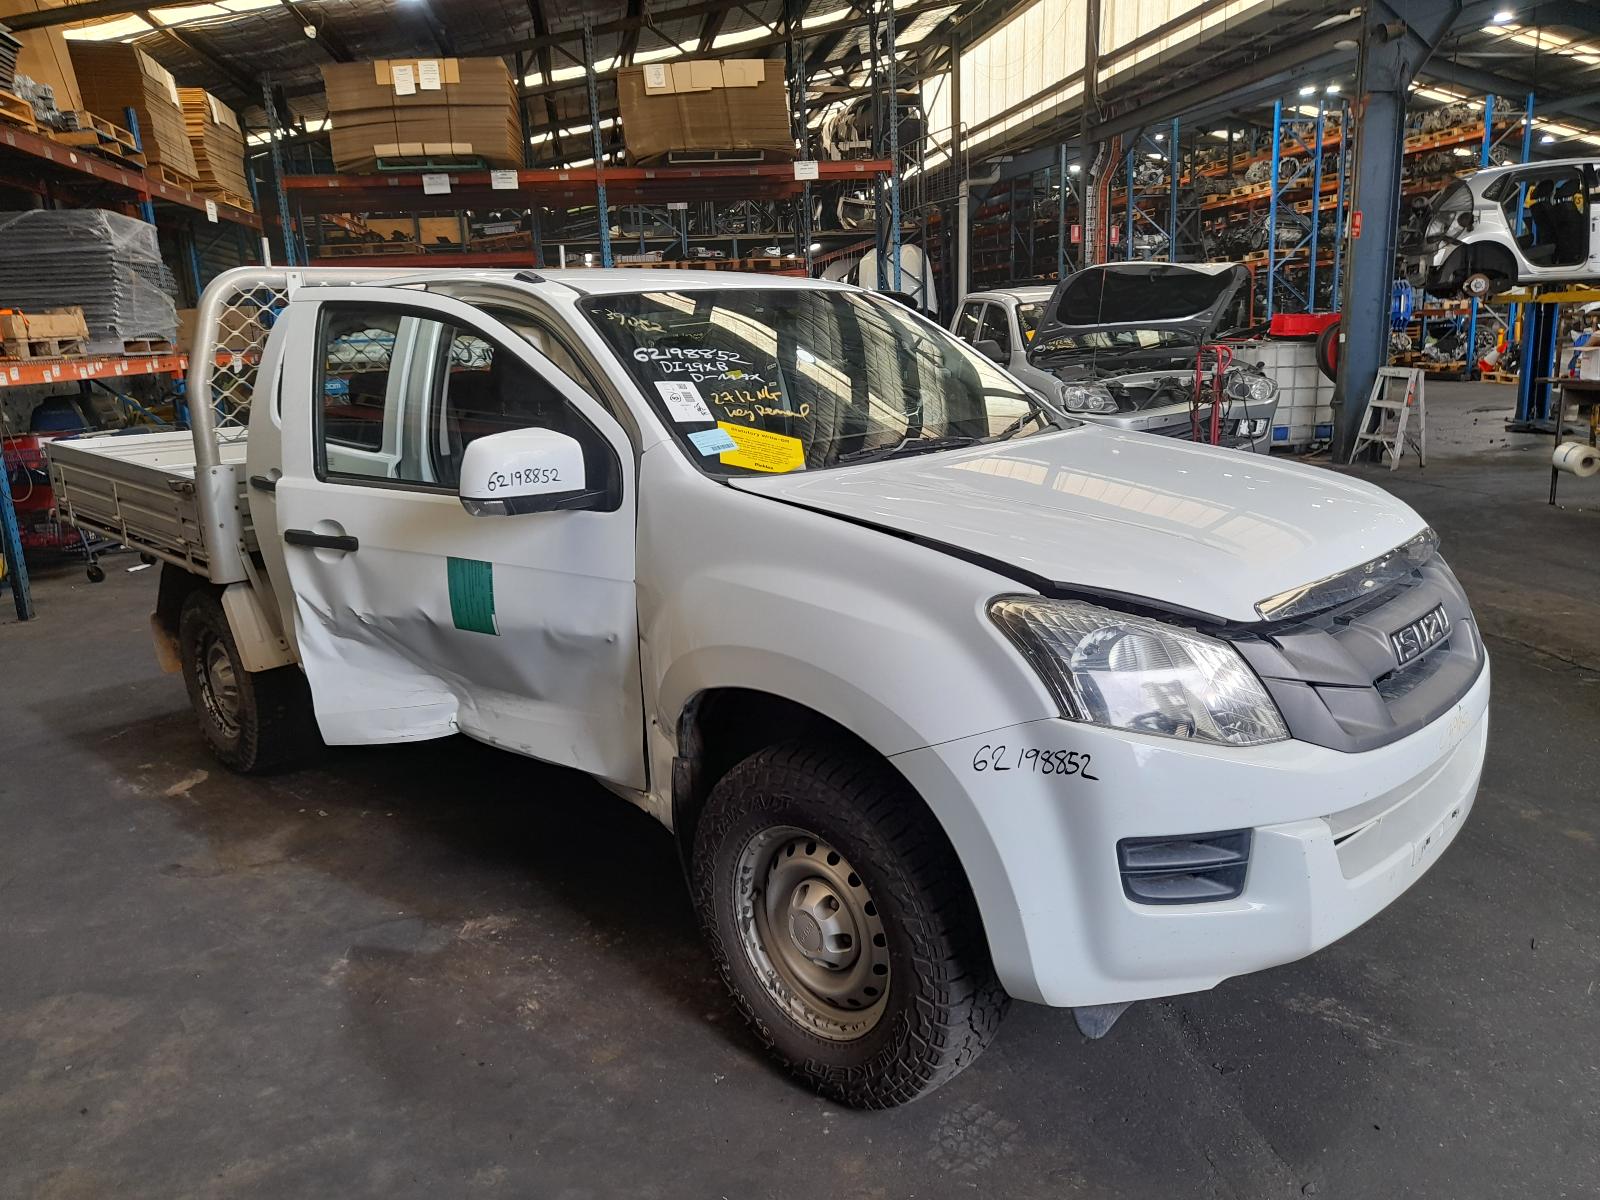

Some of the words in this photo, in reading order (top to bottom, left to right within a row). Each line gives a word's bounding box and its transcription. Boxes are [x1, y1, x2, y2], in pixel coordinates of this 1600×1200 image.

[633, 347, 753, 365] 62198852
[487, 468, 562, 491] 62198852
[1392, 605, 1450, 663] ISUZU
